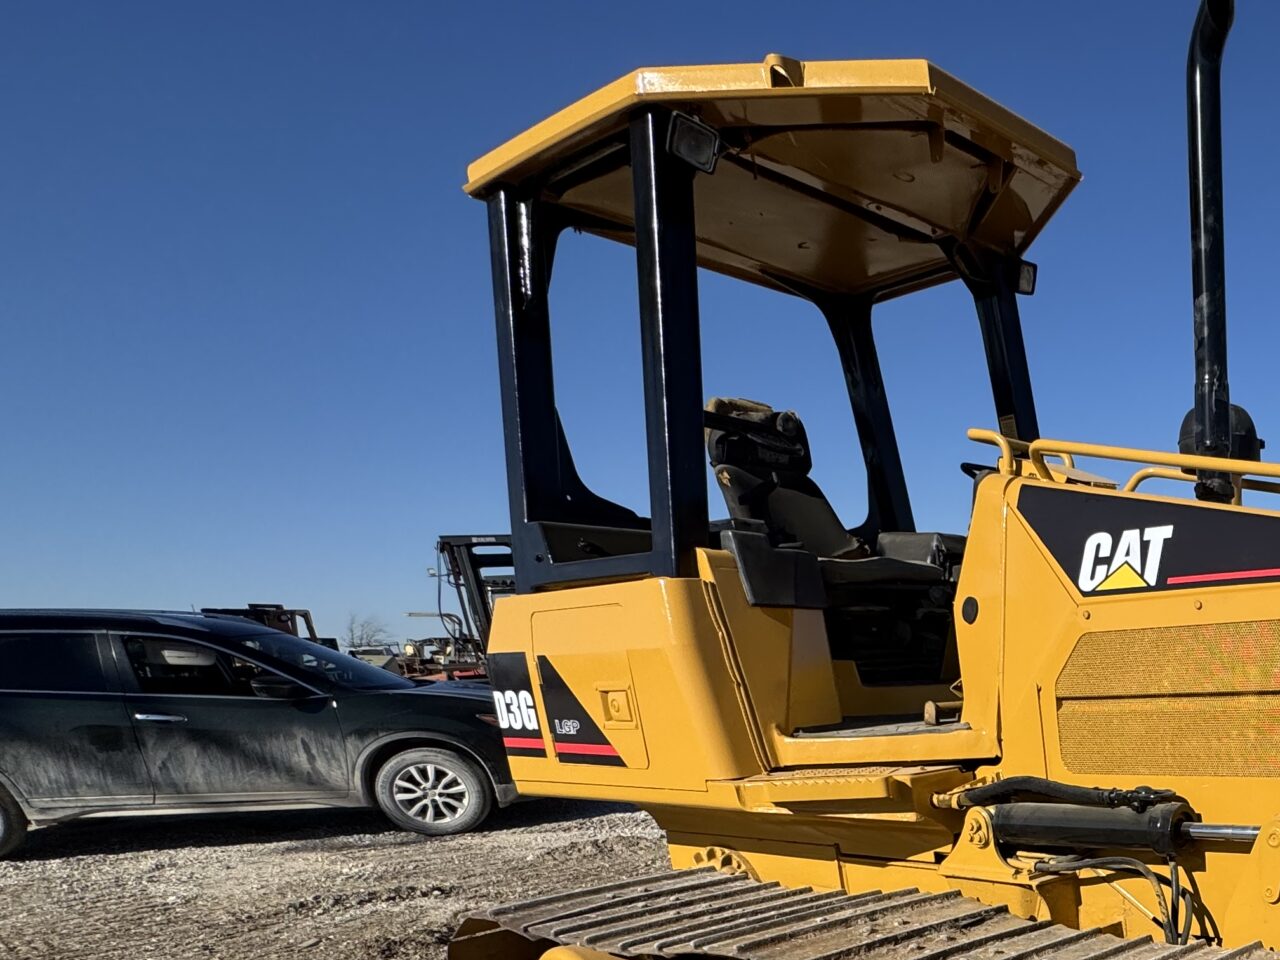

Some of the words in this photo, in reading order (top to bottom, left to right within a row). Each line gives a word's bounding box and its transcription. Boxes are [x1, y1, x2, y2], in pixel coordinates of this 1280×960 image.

[1078, 525, 1174, 592] CAT
[492, 689, 540, 731] D3G
[554, 719, 580, 735] LGP
